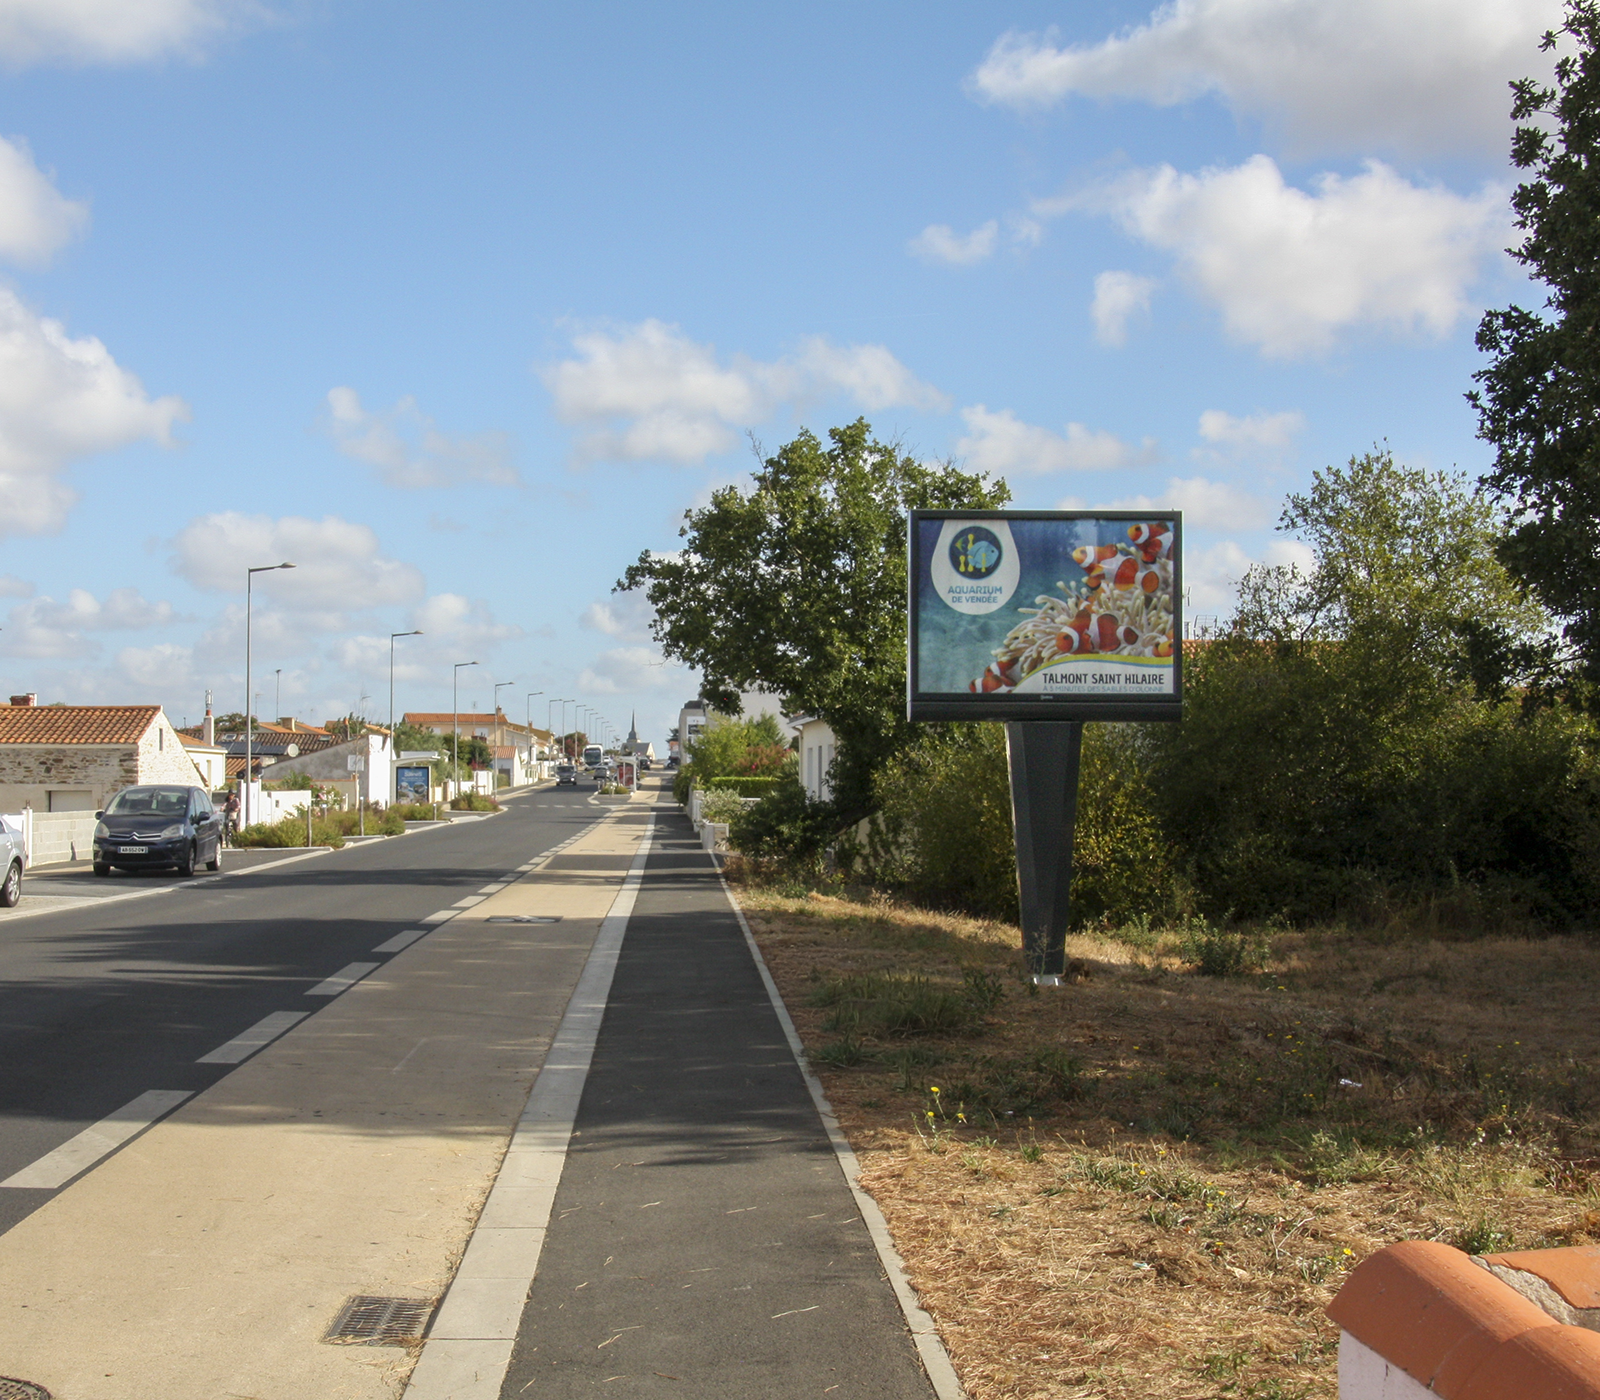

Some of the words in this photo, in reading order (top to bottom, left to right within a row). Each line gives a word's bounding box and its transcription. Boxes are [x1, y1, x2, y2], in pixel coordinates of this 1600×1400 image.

[947, 585, 1003, 594] AQUARIUM
[951, 595, 963, 603] DE
[965, 594, 998, 603] VENDÉE
[1042, 673, 1088, 684] TALMONT
[1091, 673, 1122, 684] SAINT
[1124, 673, 1165, 684] HILAIRE
